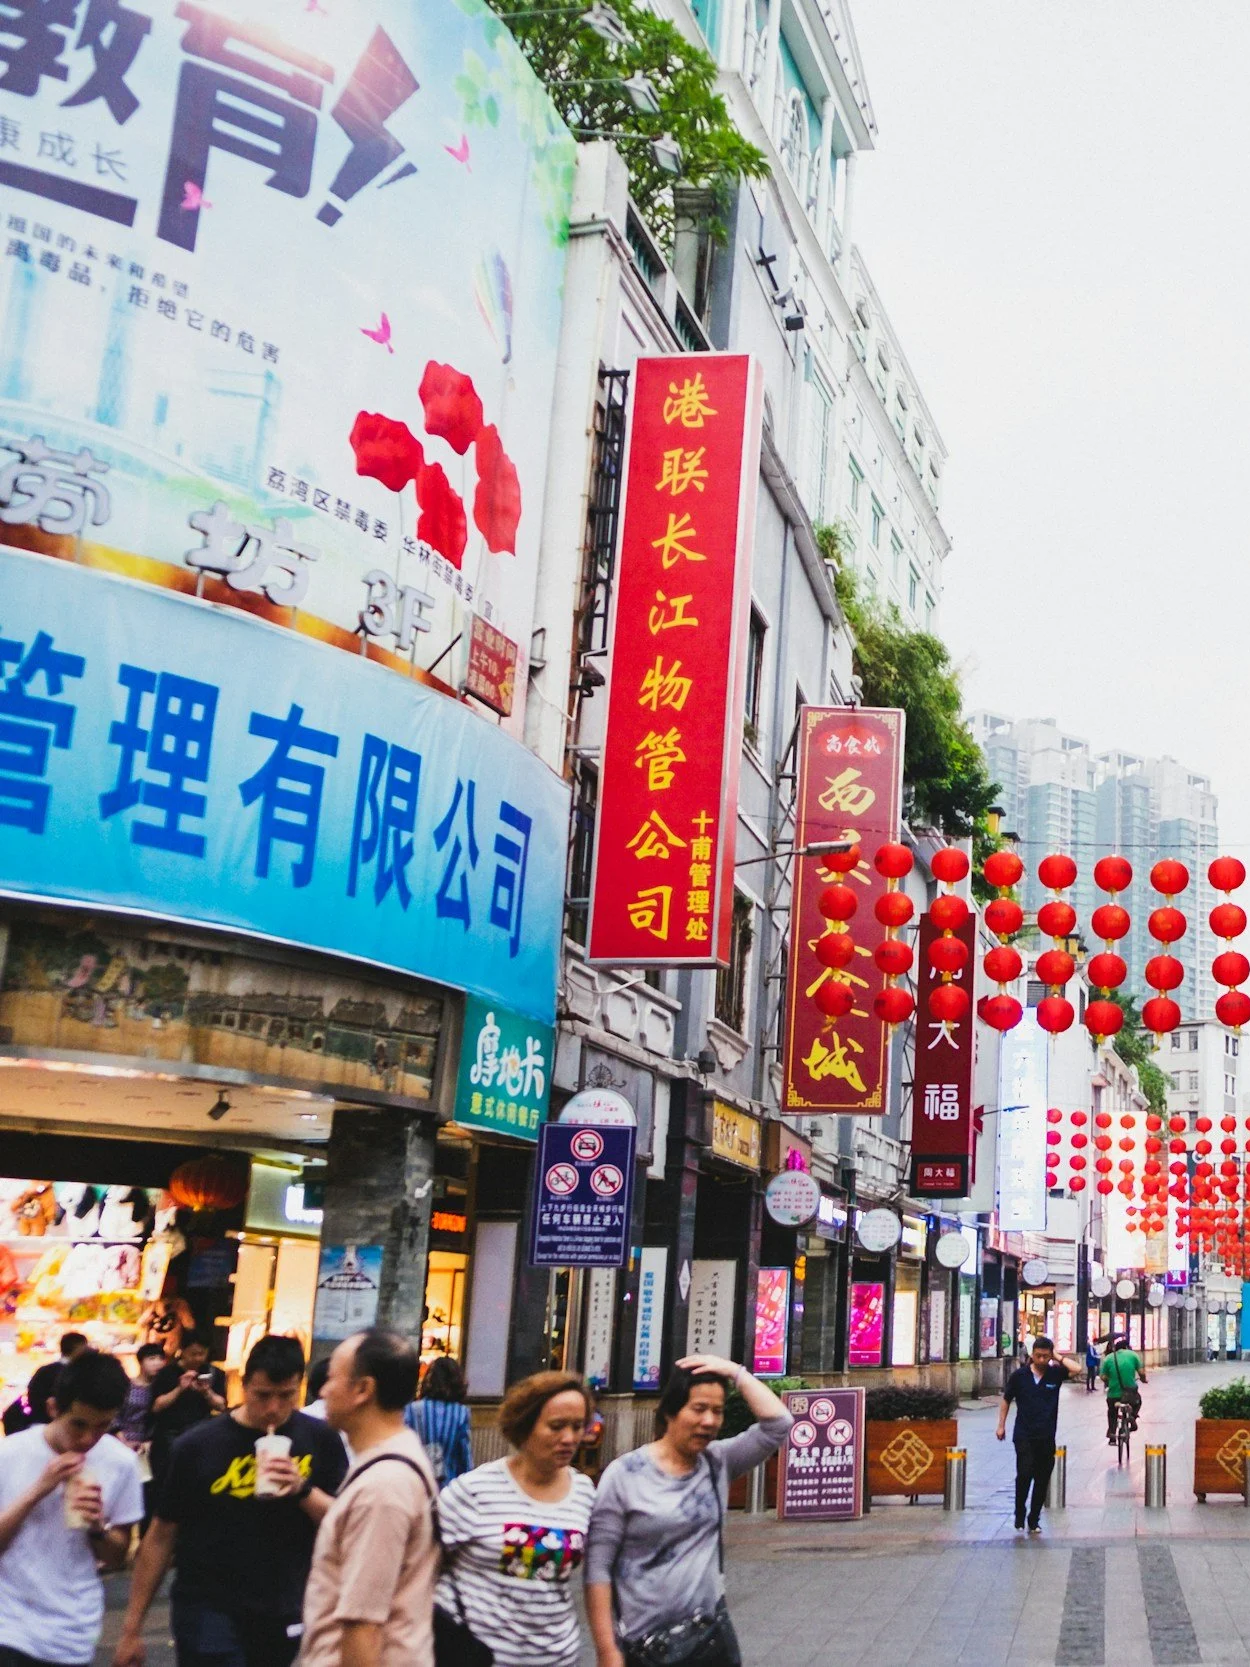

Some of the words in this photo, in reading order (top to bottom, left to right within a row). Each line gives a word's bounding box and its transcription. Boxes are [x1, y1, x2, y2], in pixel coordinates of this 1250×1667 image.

[0, 630, 533, 958] 管理有限公司
[626, 372, 718, 941] 港联长江物管公司
[686, 810, 715, 941] 十甫管理处
